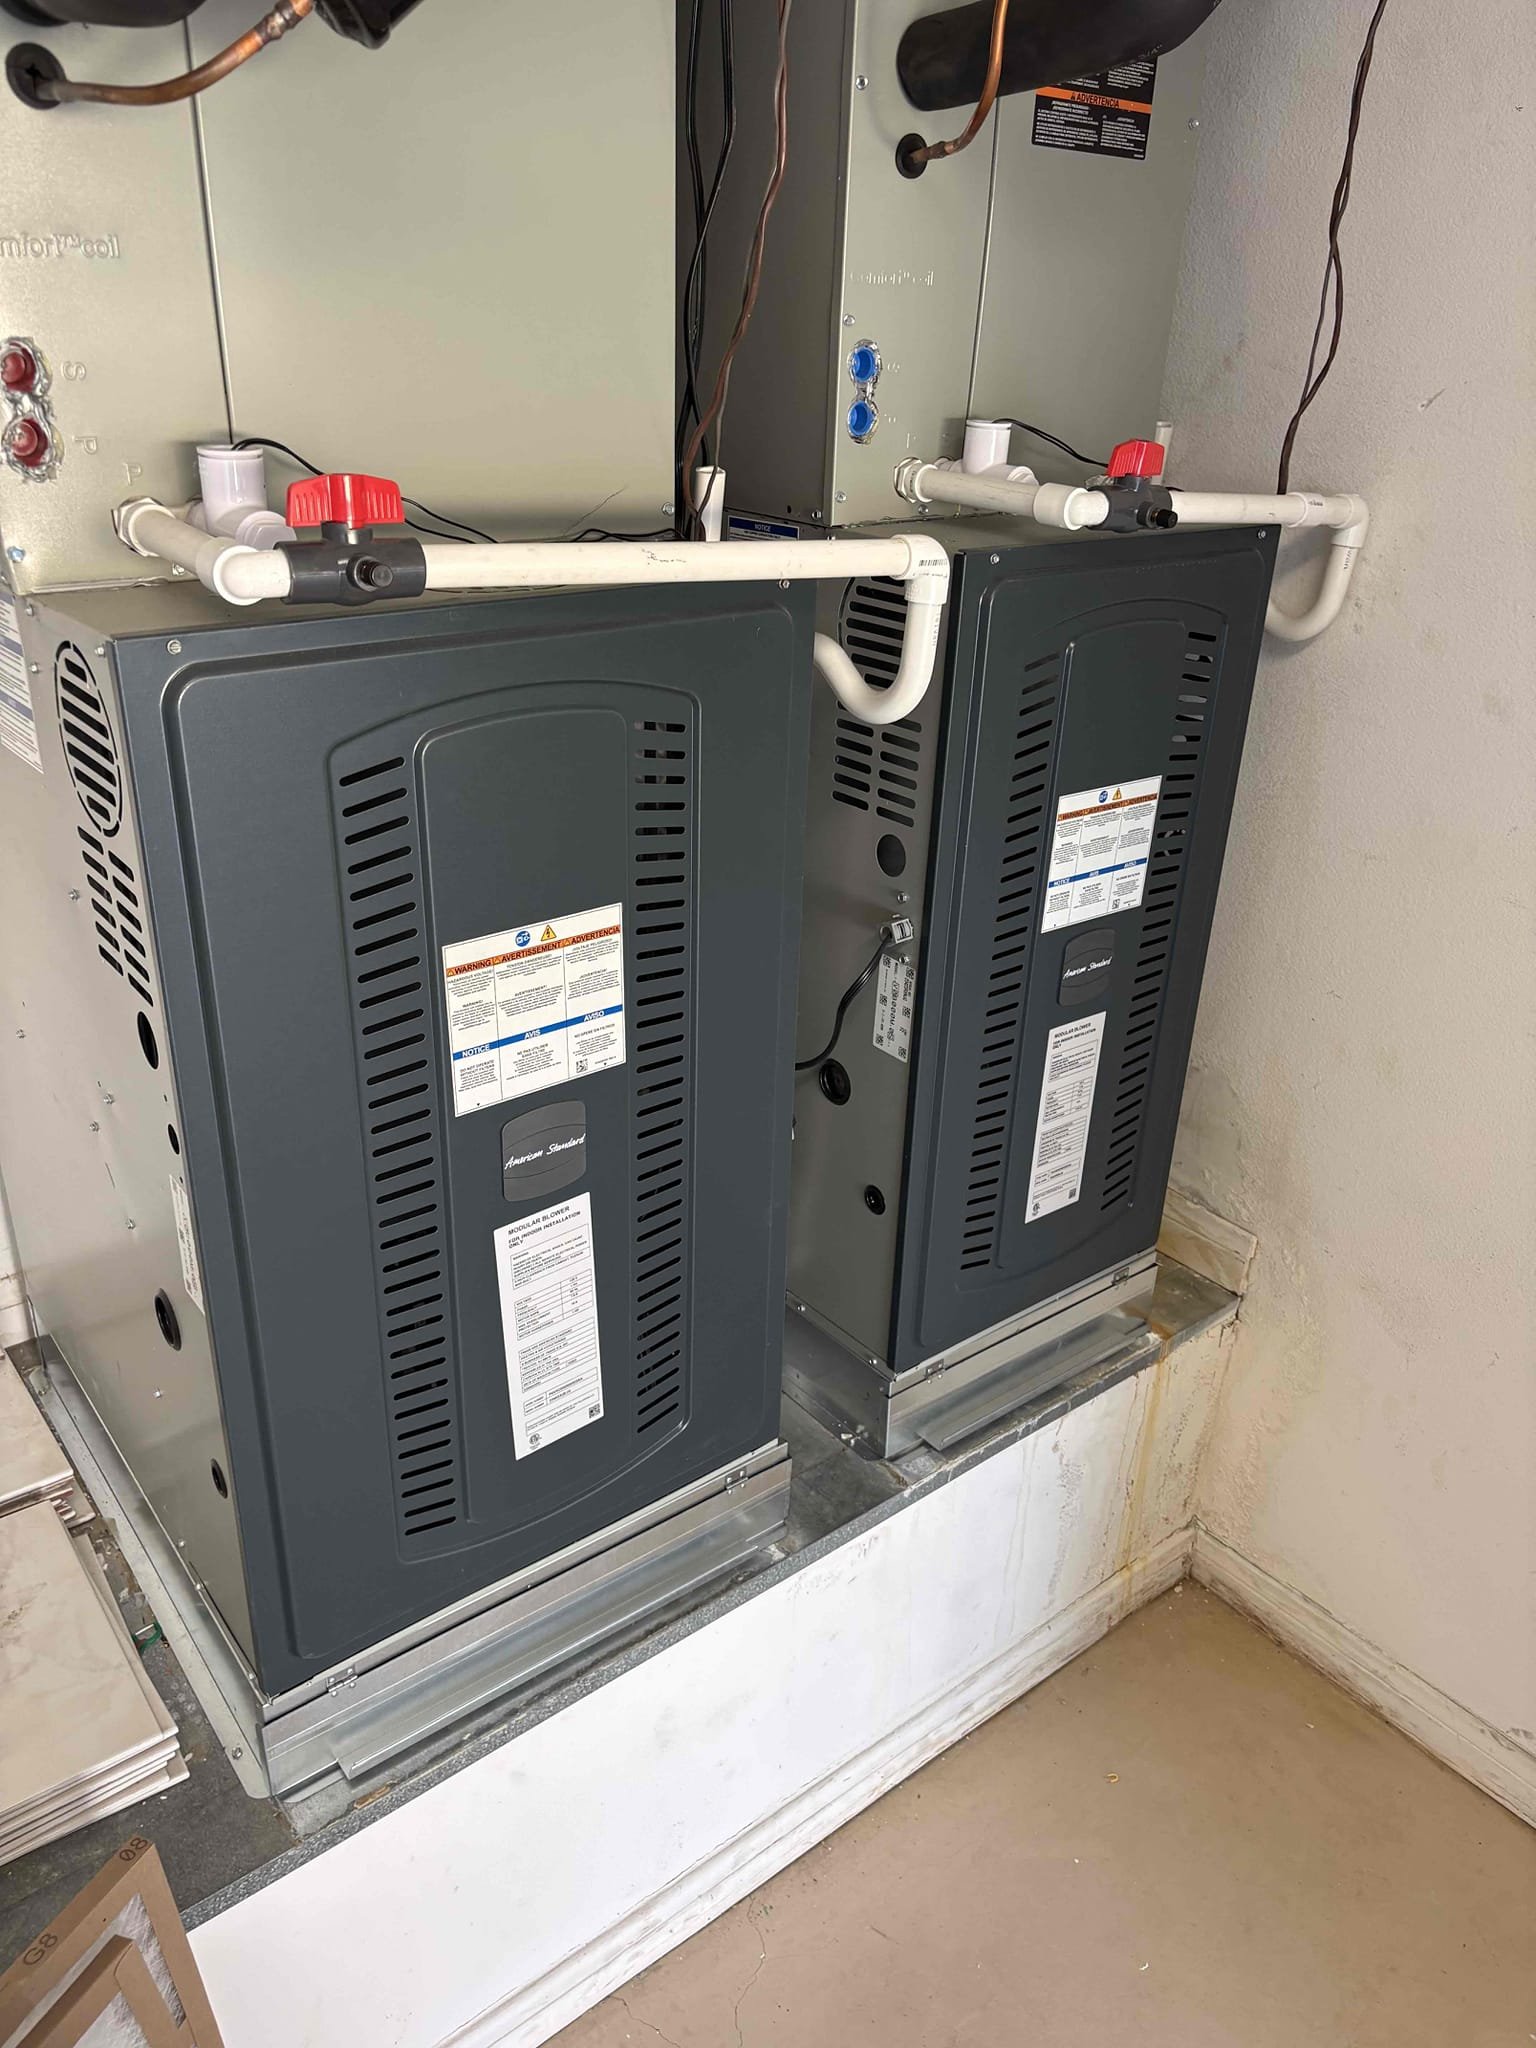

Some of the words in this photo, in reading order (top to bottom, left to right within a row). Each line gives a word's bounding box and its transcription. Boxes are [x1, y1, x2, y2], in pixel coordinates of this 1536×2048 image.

[1076, 93, 1120, 106] ADVERTENCIA
[124, 462, 142, 486] P
[754, 523, 771, 532] NOTICE
[571, 926, 620, 944] ADVERTENCIA
[501, 941, 560, 962] AVERTISSEMENT
[454, 959, 491, 974] WARNING
[1063, 966, 1087, 980] American
[1087, 956, 1113, 972] Standard
[583, 1010, 604, 1022] AVISO
[524, 1029, 540, 1039] AVIS
[462, 1044, 489, 1057] NOTICE
[504, 1150, 544, 1170] American
[546, 1133, 586, 1155] Standard
[508, 1218, 540, 1235] MODULAR
[541, 1206, 569, 1221] BLOWER
[521, 1227, 541, 1238] INDOOR
[543, 1211, 580, 1229] INSTALLATION
[508, 1240, 523, 1248] ONLY
[23, 1934, 58, 1966] G8
